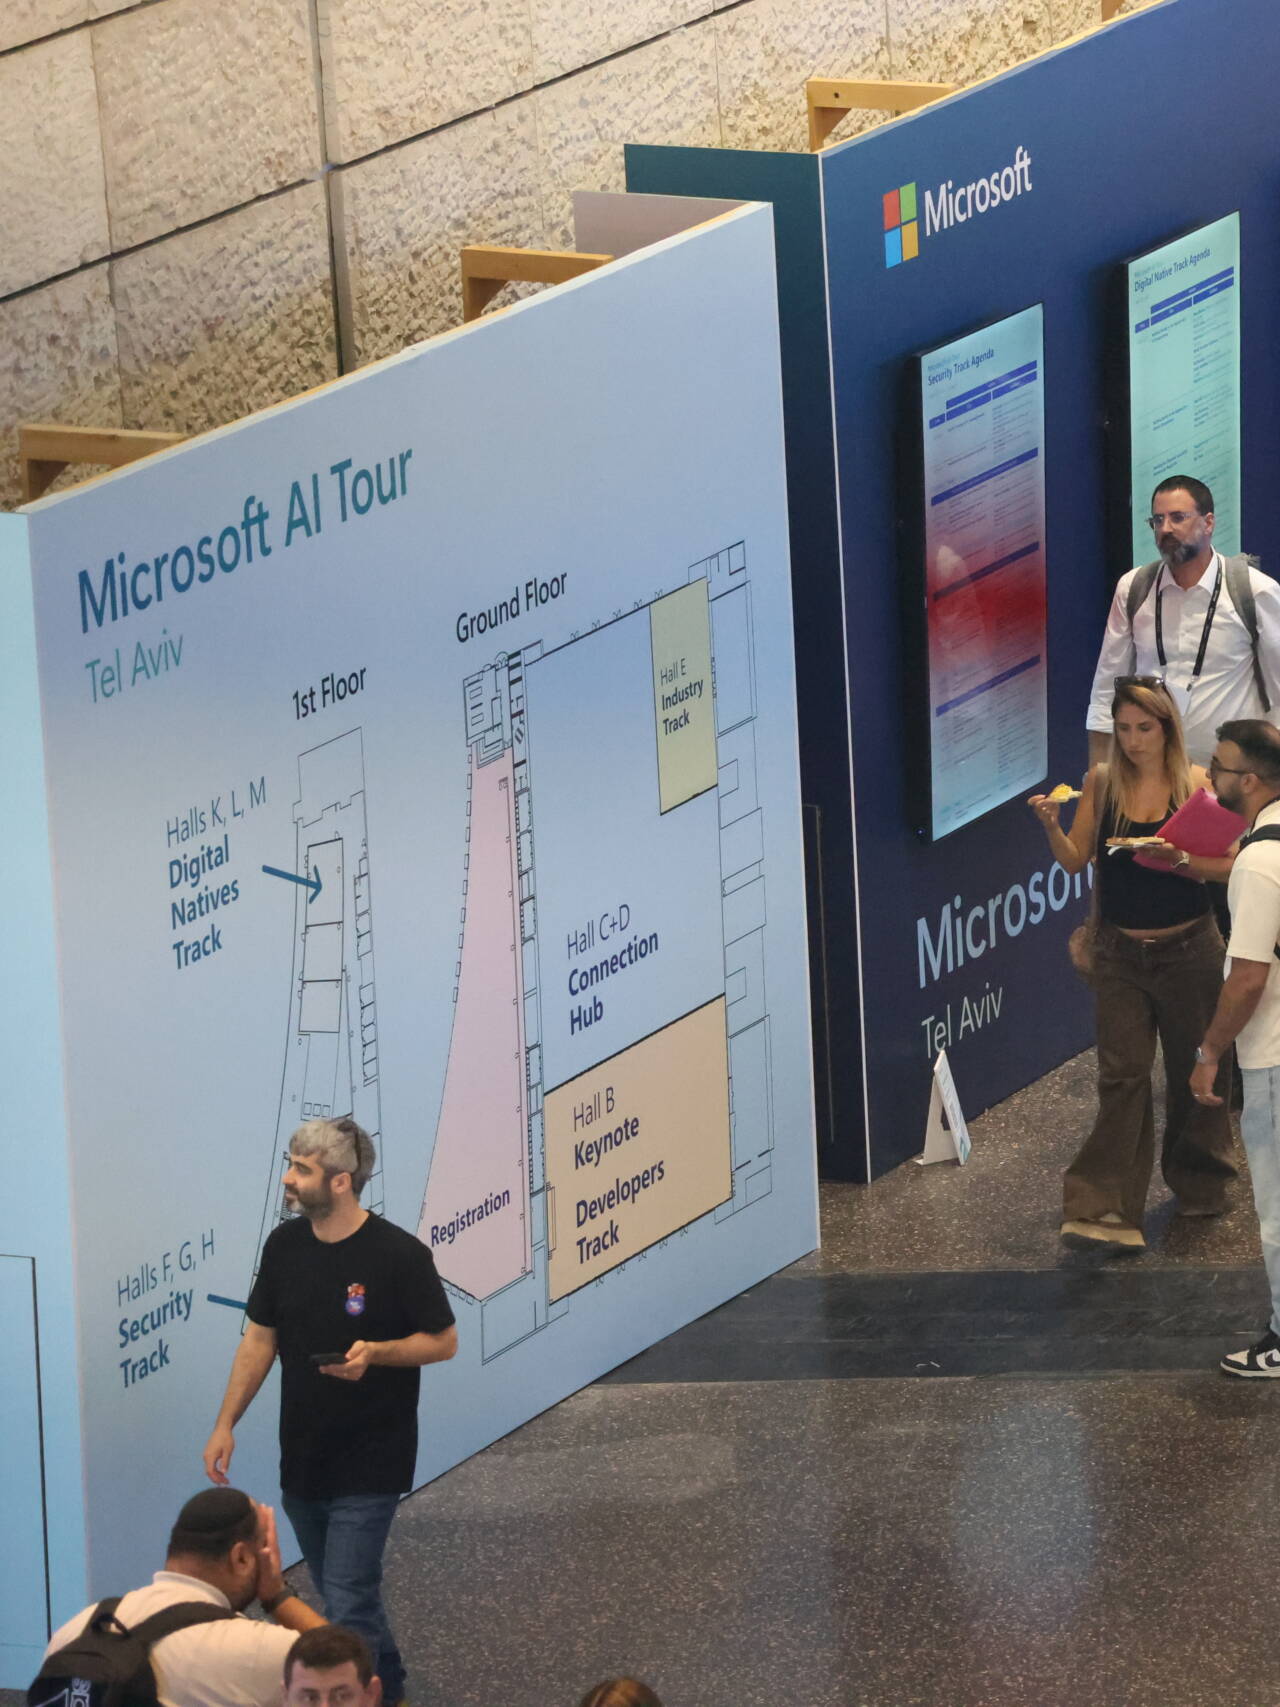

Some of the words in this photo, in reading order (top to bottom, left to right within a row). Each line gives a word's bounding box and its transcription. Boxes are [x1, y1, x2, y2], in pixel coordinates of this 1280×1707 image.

[925, 146, 1032, 236] Microsoft
[1134, 275, 1154, 293] Digital
[1154, 265, 1172, 281] Native
[1173, 257, 1188, 273] Track
[1189, 248, 1211, 267] Agenda
[928, 368, 952, 387] Security
[954, 359, 970, 374] Track
[972, 347, 994, 369] Agenda
[77, 496, 271, 633] Microsoft
[285, 473, 322, 548] AI
[330, 449, 414, 524] Tour
[456, 587, 519, 643] Ground
[525, 572, 567, 611] Floor
[85, 648, 122, 704] Tel
[131, 628, 184, 688] Aviv
[292, 684, 317, 720] 1st
[322, 667, 366, 707] Floor
[661, 661, 677, 685] Hall
[680, 658, 687, 676] E
[661, 677, 704, 712] Industry
[663, 709, 690, 736] Track
[166, 806, 207, 848] Halls
[210, 797, 226, 829] K,
[231, 790, 244, 819] L,
[249, 776, 266, 807] M
[168, 835, 230, 890] Digital
[170, 880, 240, 930] Natives
[567, 925, 595, 959] Hall
[599, 904, 630, 941] C+D
[172, 924, 222, 969] Track
[568, 930, 658, 996] Connection
[570, 995, 604, 1035] Hub
[921, 1004, 952, 1058] Tel
[959, 982, 1003, 1040] Aviv
[573, 1091, 601, 1132] Hall
[604, 1087, 615, 1115] B
[573, 1113, 640, 1170] Keynote
[430, 1190, 511, 1247] Registration
[576, 1159, 665, 1227] Developers
[117, 1263, 157, 1304] Halls
[162, 1252, 174, 1283] F,
[179, 1241, 196, 1272] G,
[202, 1229, 215, 1261] H
[577, 1221, 620, 1264] Track
[118, 1288, 193, 1347] Security
[119, 1339, 169, 1387] Track
